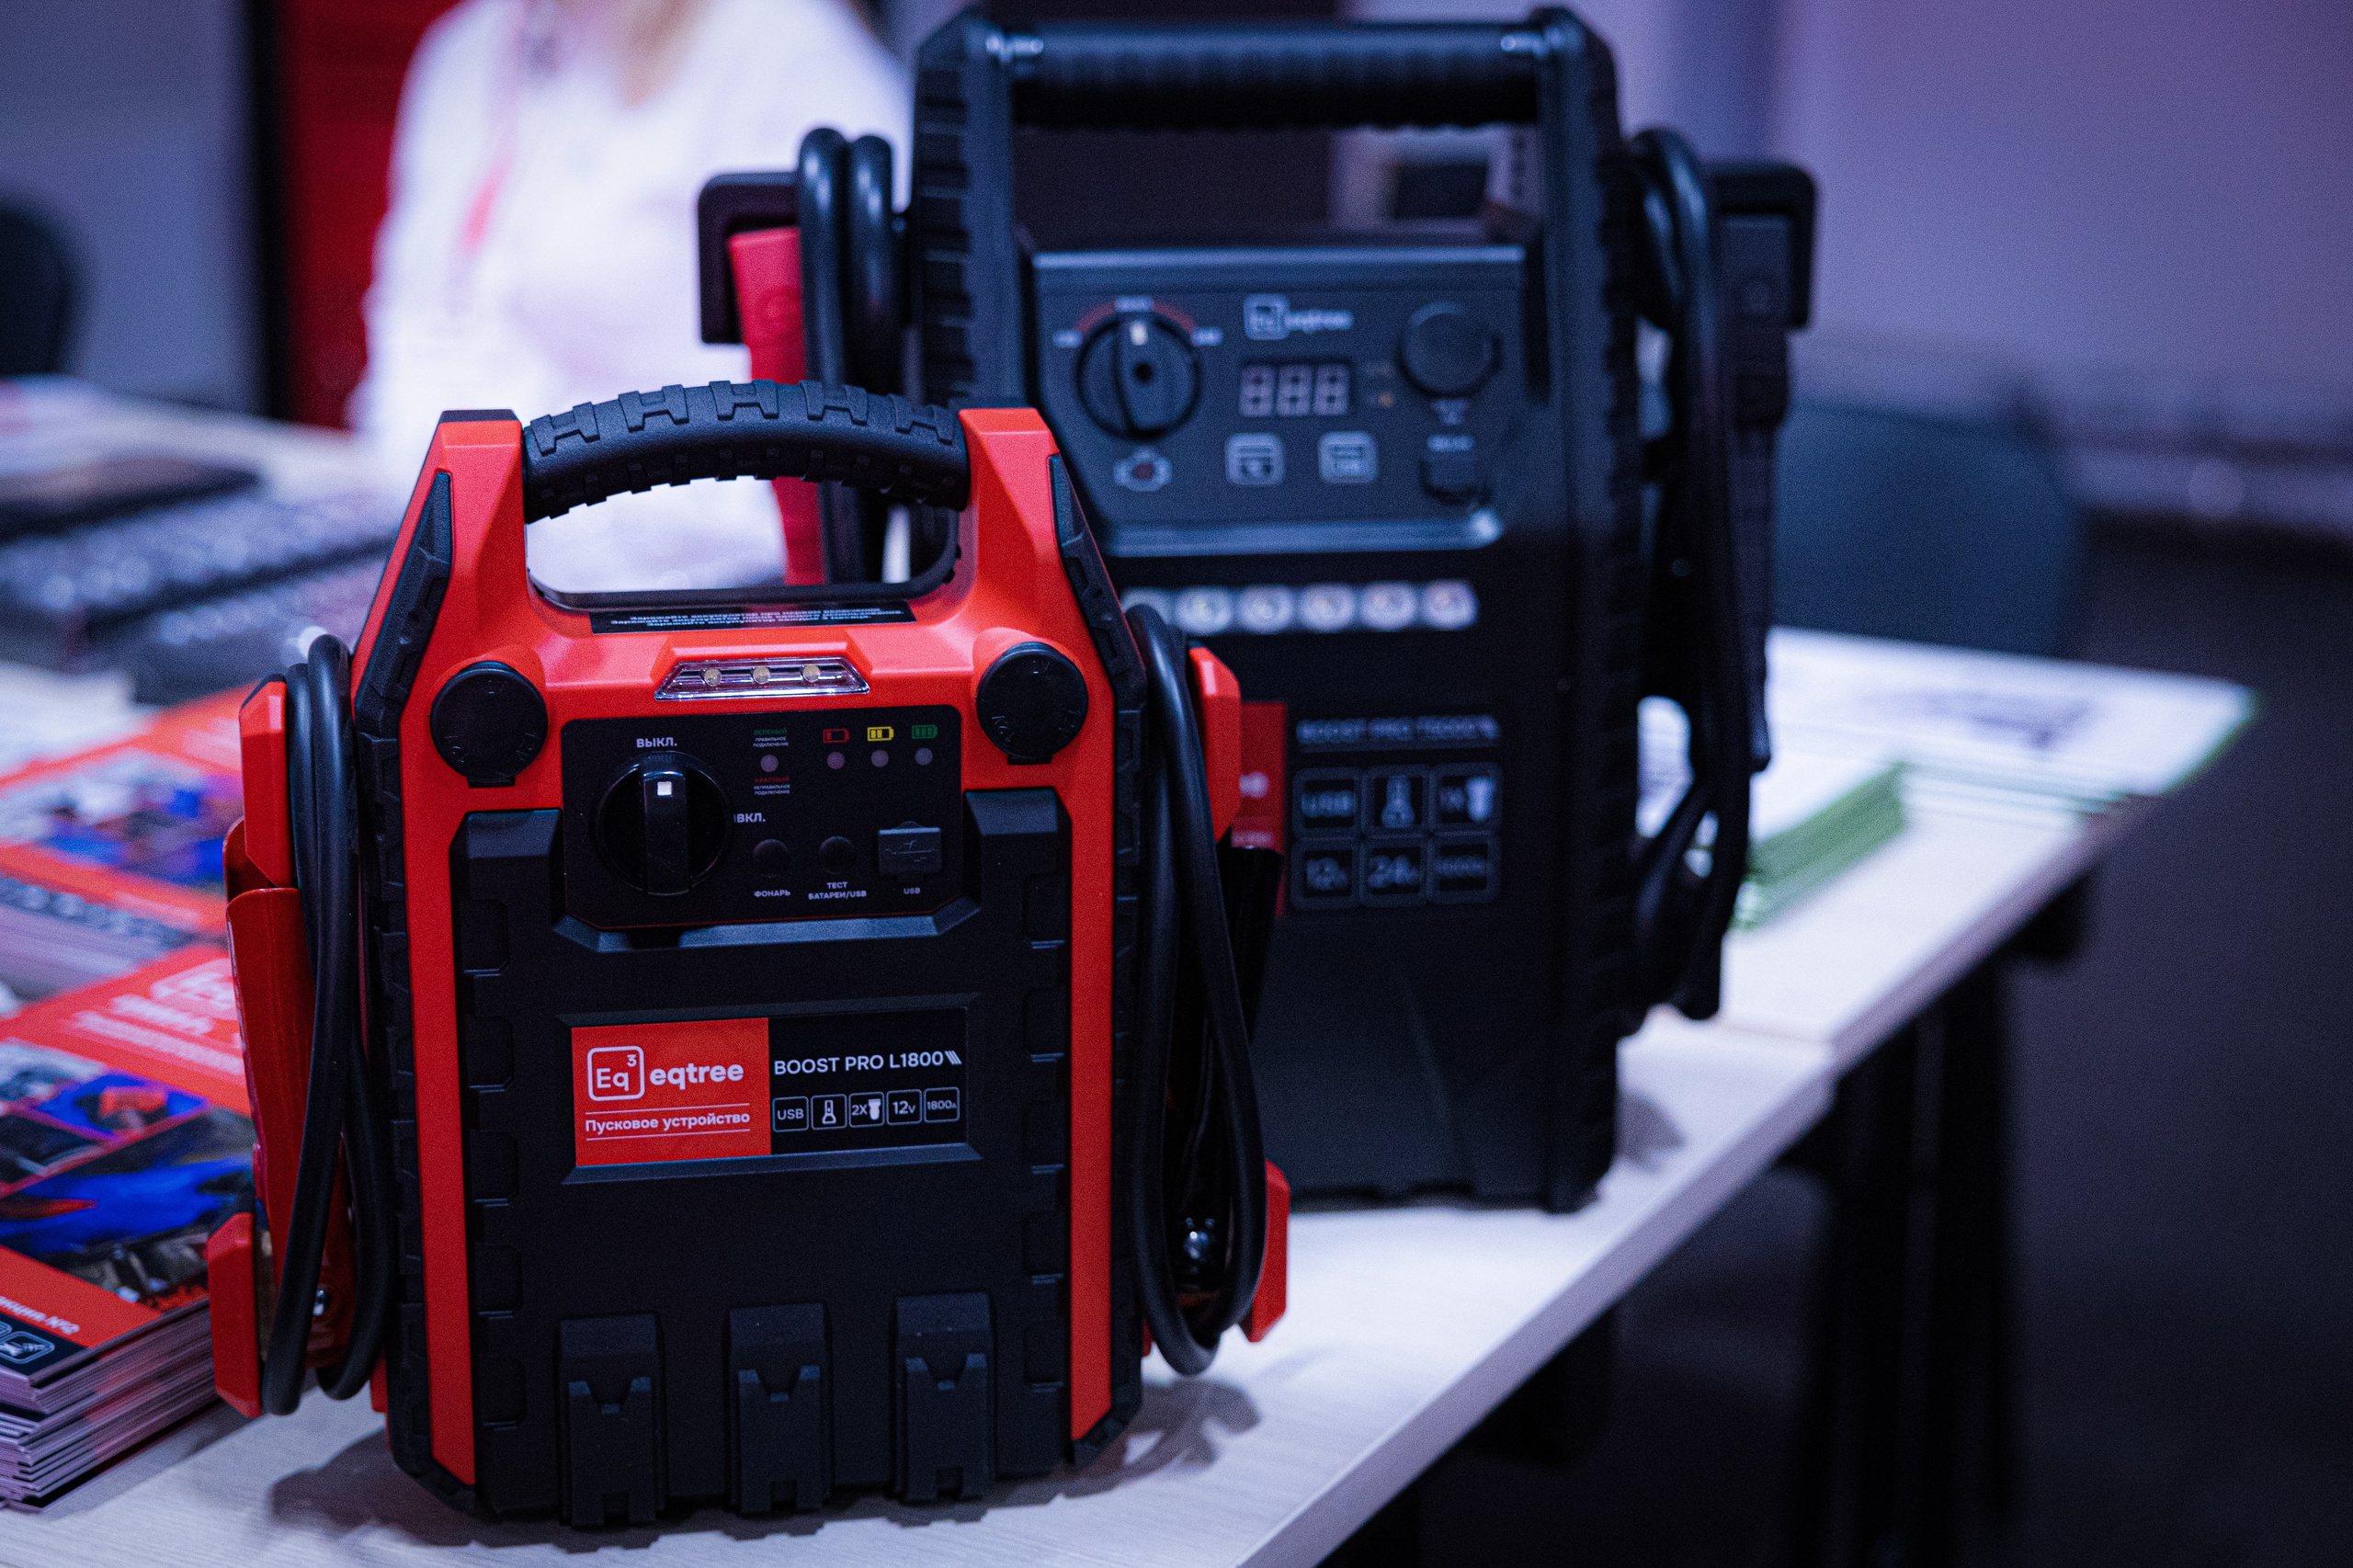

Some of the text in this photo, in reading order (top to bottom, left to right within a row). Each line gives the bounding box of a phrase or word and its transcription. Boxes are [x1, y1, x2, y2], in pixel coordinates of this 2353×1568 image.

[635, 736, 678, 748] ВЫКЛ.
[736, 812, 767, 824] ВКЛ.
[826, 881, 848, 890] ТЕСТ
[903, 887, 921, 895] USB
[753, 889, 791, 898] ФОНАРЬ
[774, 1050, 945, 1075] BOOST PRO L1800
[649, 1062, 745, 1090] eqtree
[777, 1108, 804, 1121] USB
[585, 1112, 751, 1134] Пусковое устройство
